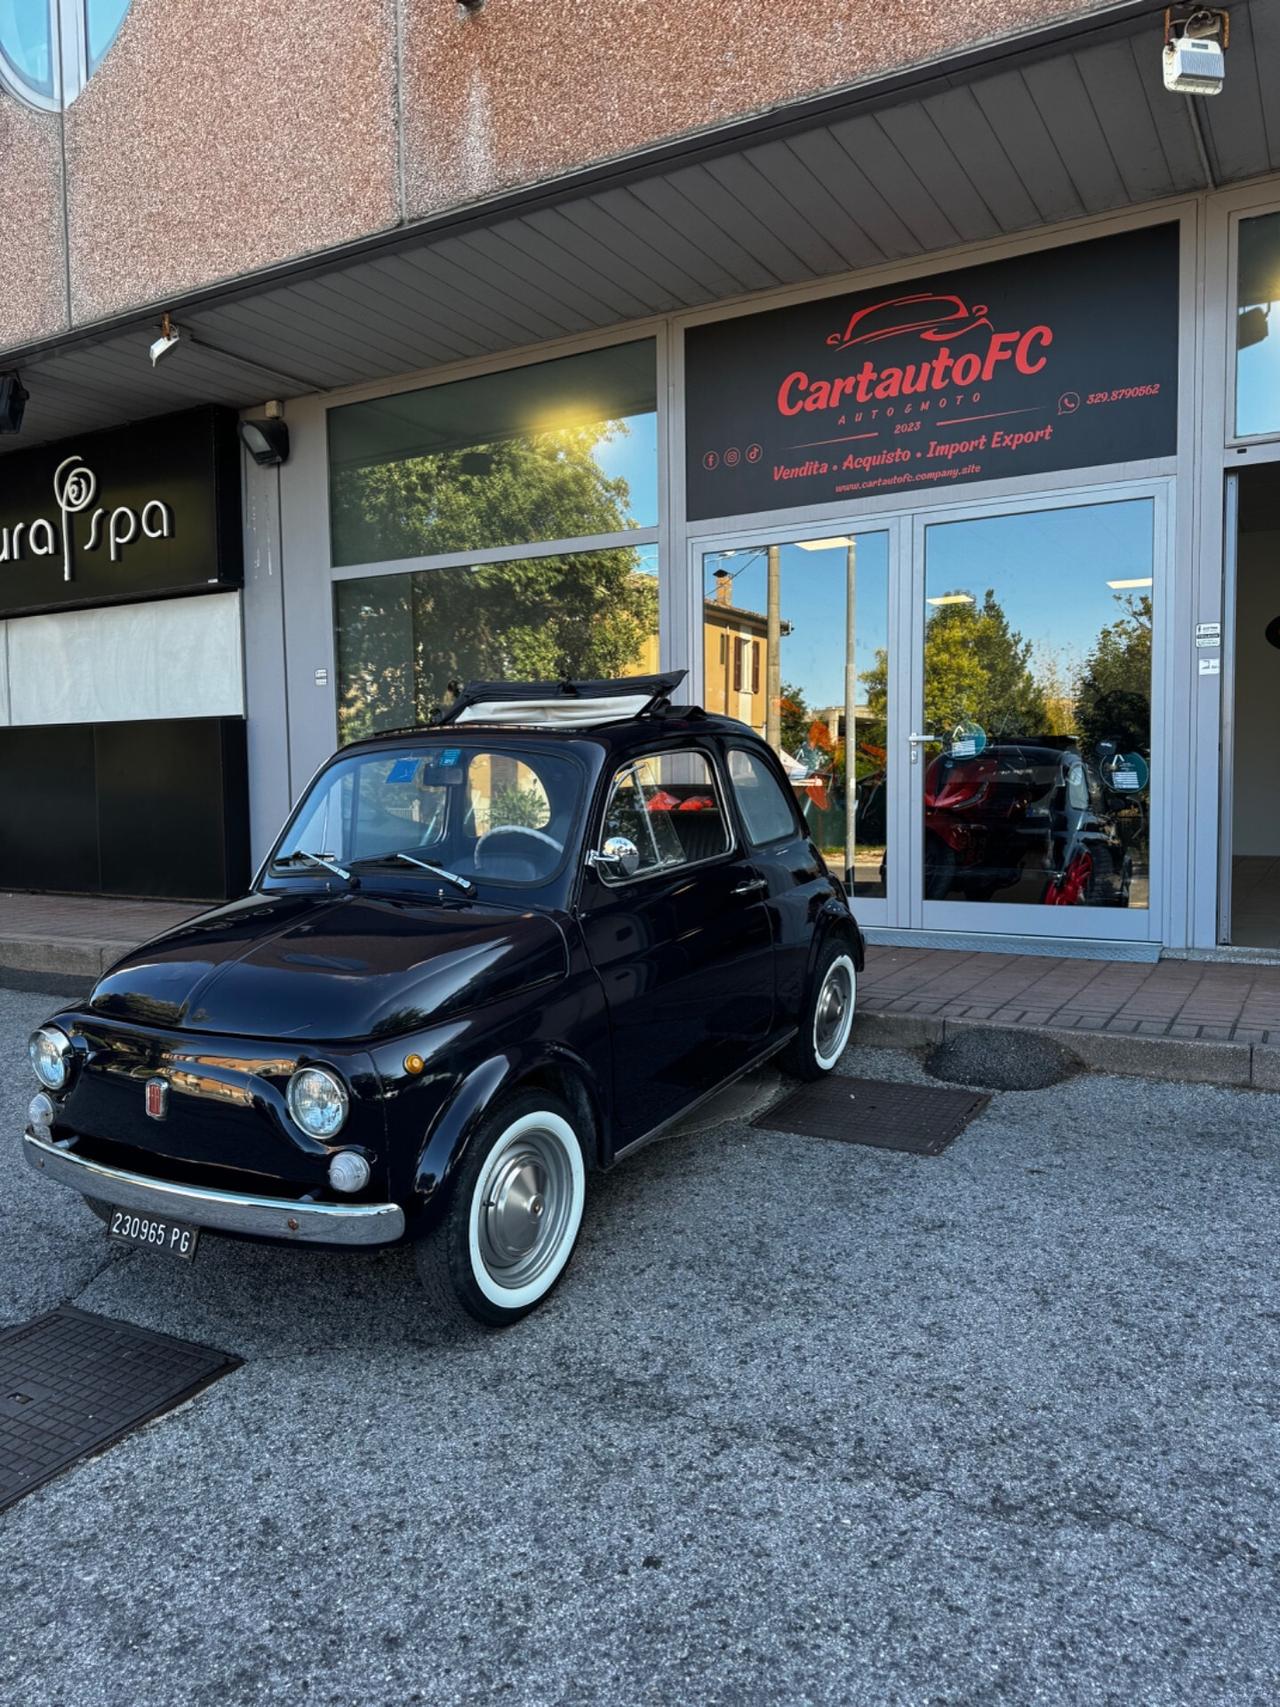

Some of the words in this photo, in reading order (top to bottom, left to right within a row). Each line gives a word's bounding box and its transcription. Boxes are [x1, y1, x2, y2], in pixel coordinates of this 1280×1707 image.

[777, 325, 1053, 416] CartautoFC
[1086, 384, 1161, 404] 329.8790562
[894, 421, 922, 434] 2023
[773, 460, 828, 481] Vendita
[842, 446, 911, 475] Acquisto
[927, 433, 987, 459] Import
[991, 424, 1054, 451] Export
[835, 463, 982, 493] www.cartautofc.company.site
[84, 500, 169, 561] spa
[112, 1212, 166, 1245] 230965
[170, 1227, 190, 1253] PG
